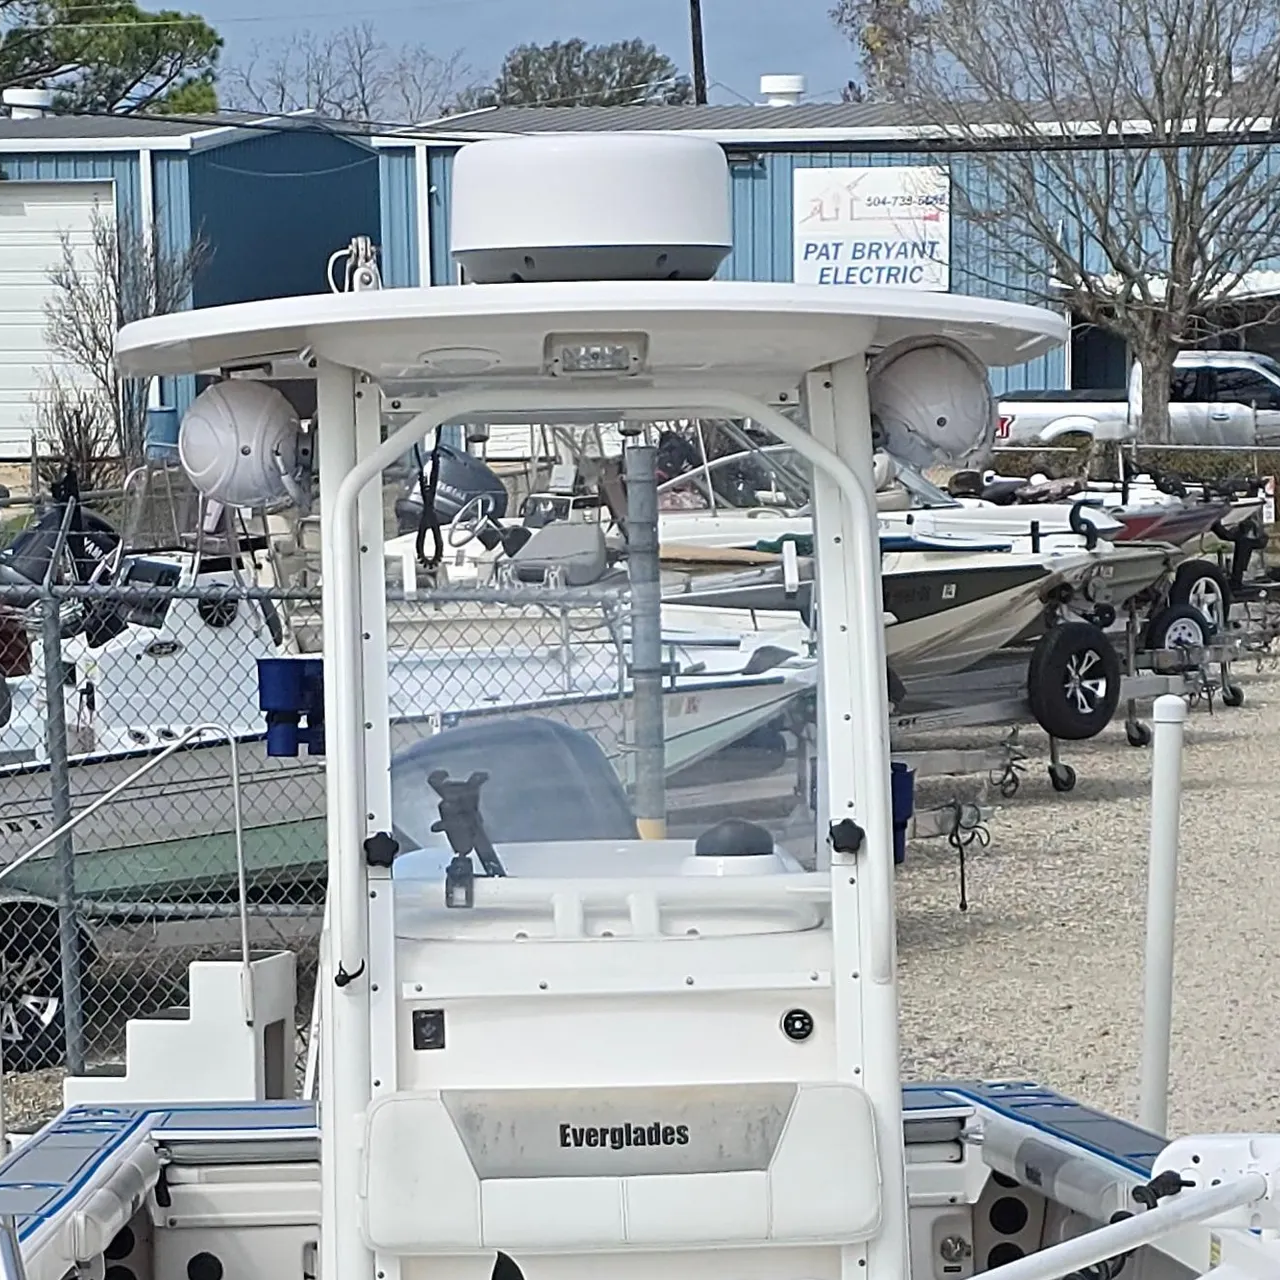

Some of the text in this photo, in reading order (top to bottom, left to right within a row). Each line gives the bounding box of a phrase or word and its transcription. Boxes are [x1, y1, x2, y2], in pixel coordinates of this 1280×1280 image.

[803, 242, 940, 261] PAT BRYANT
[818, 264, 924, 285] ELECTRIC
[559, 1121, 689, 1150] Everglades
